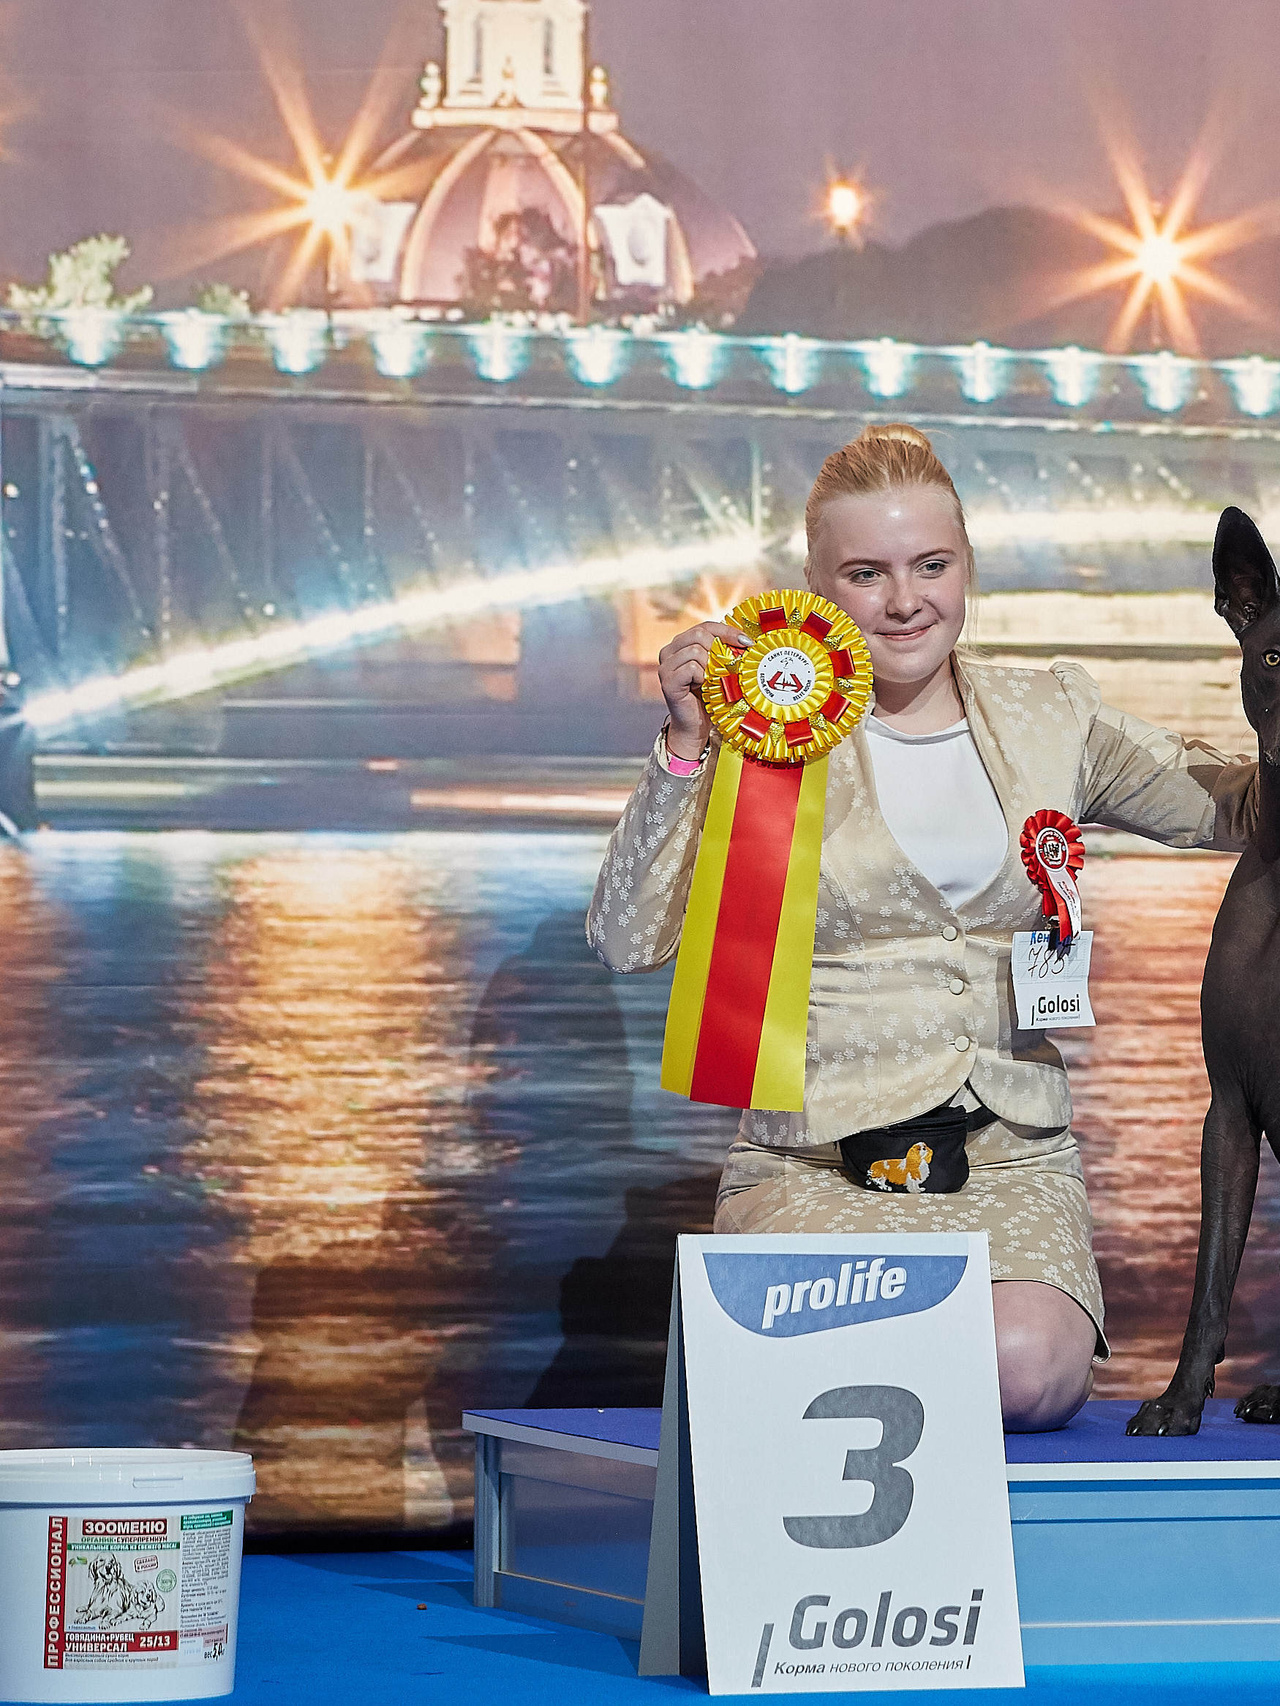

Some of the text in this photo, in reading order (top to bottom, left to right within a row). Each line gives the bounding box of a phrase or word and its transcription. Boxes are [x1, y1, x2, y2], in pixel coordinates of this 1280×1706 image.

[1038, 994, 1080, 1014] Golosi
[761, 1257, 908, 1329] prolife
[782, 1384, 925, 1549] 3
[84, 1520, 165, 1534] ЗООМЕНЮ
[46, 1516, 64, 1667] ПРОФЕССИОНАЛ
[788, 1588, 984, 1651] Golosi
[65, 1642, 128, 1652] УНИВЕРСАЛ
[140, 1635, 171, 1648] 25/13
[773, 1659, 964, 1677] Корма нового поколения
